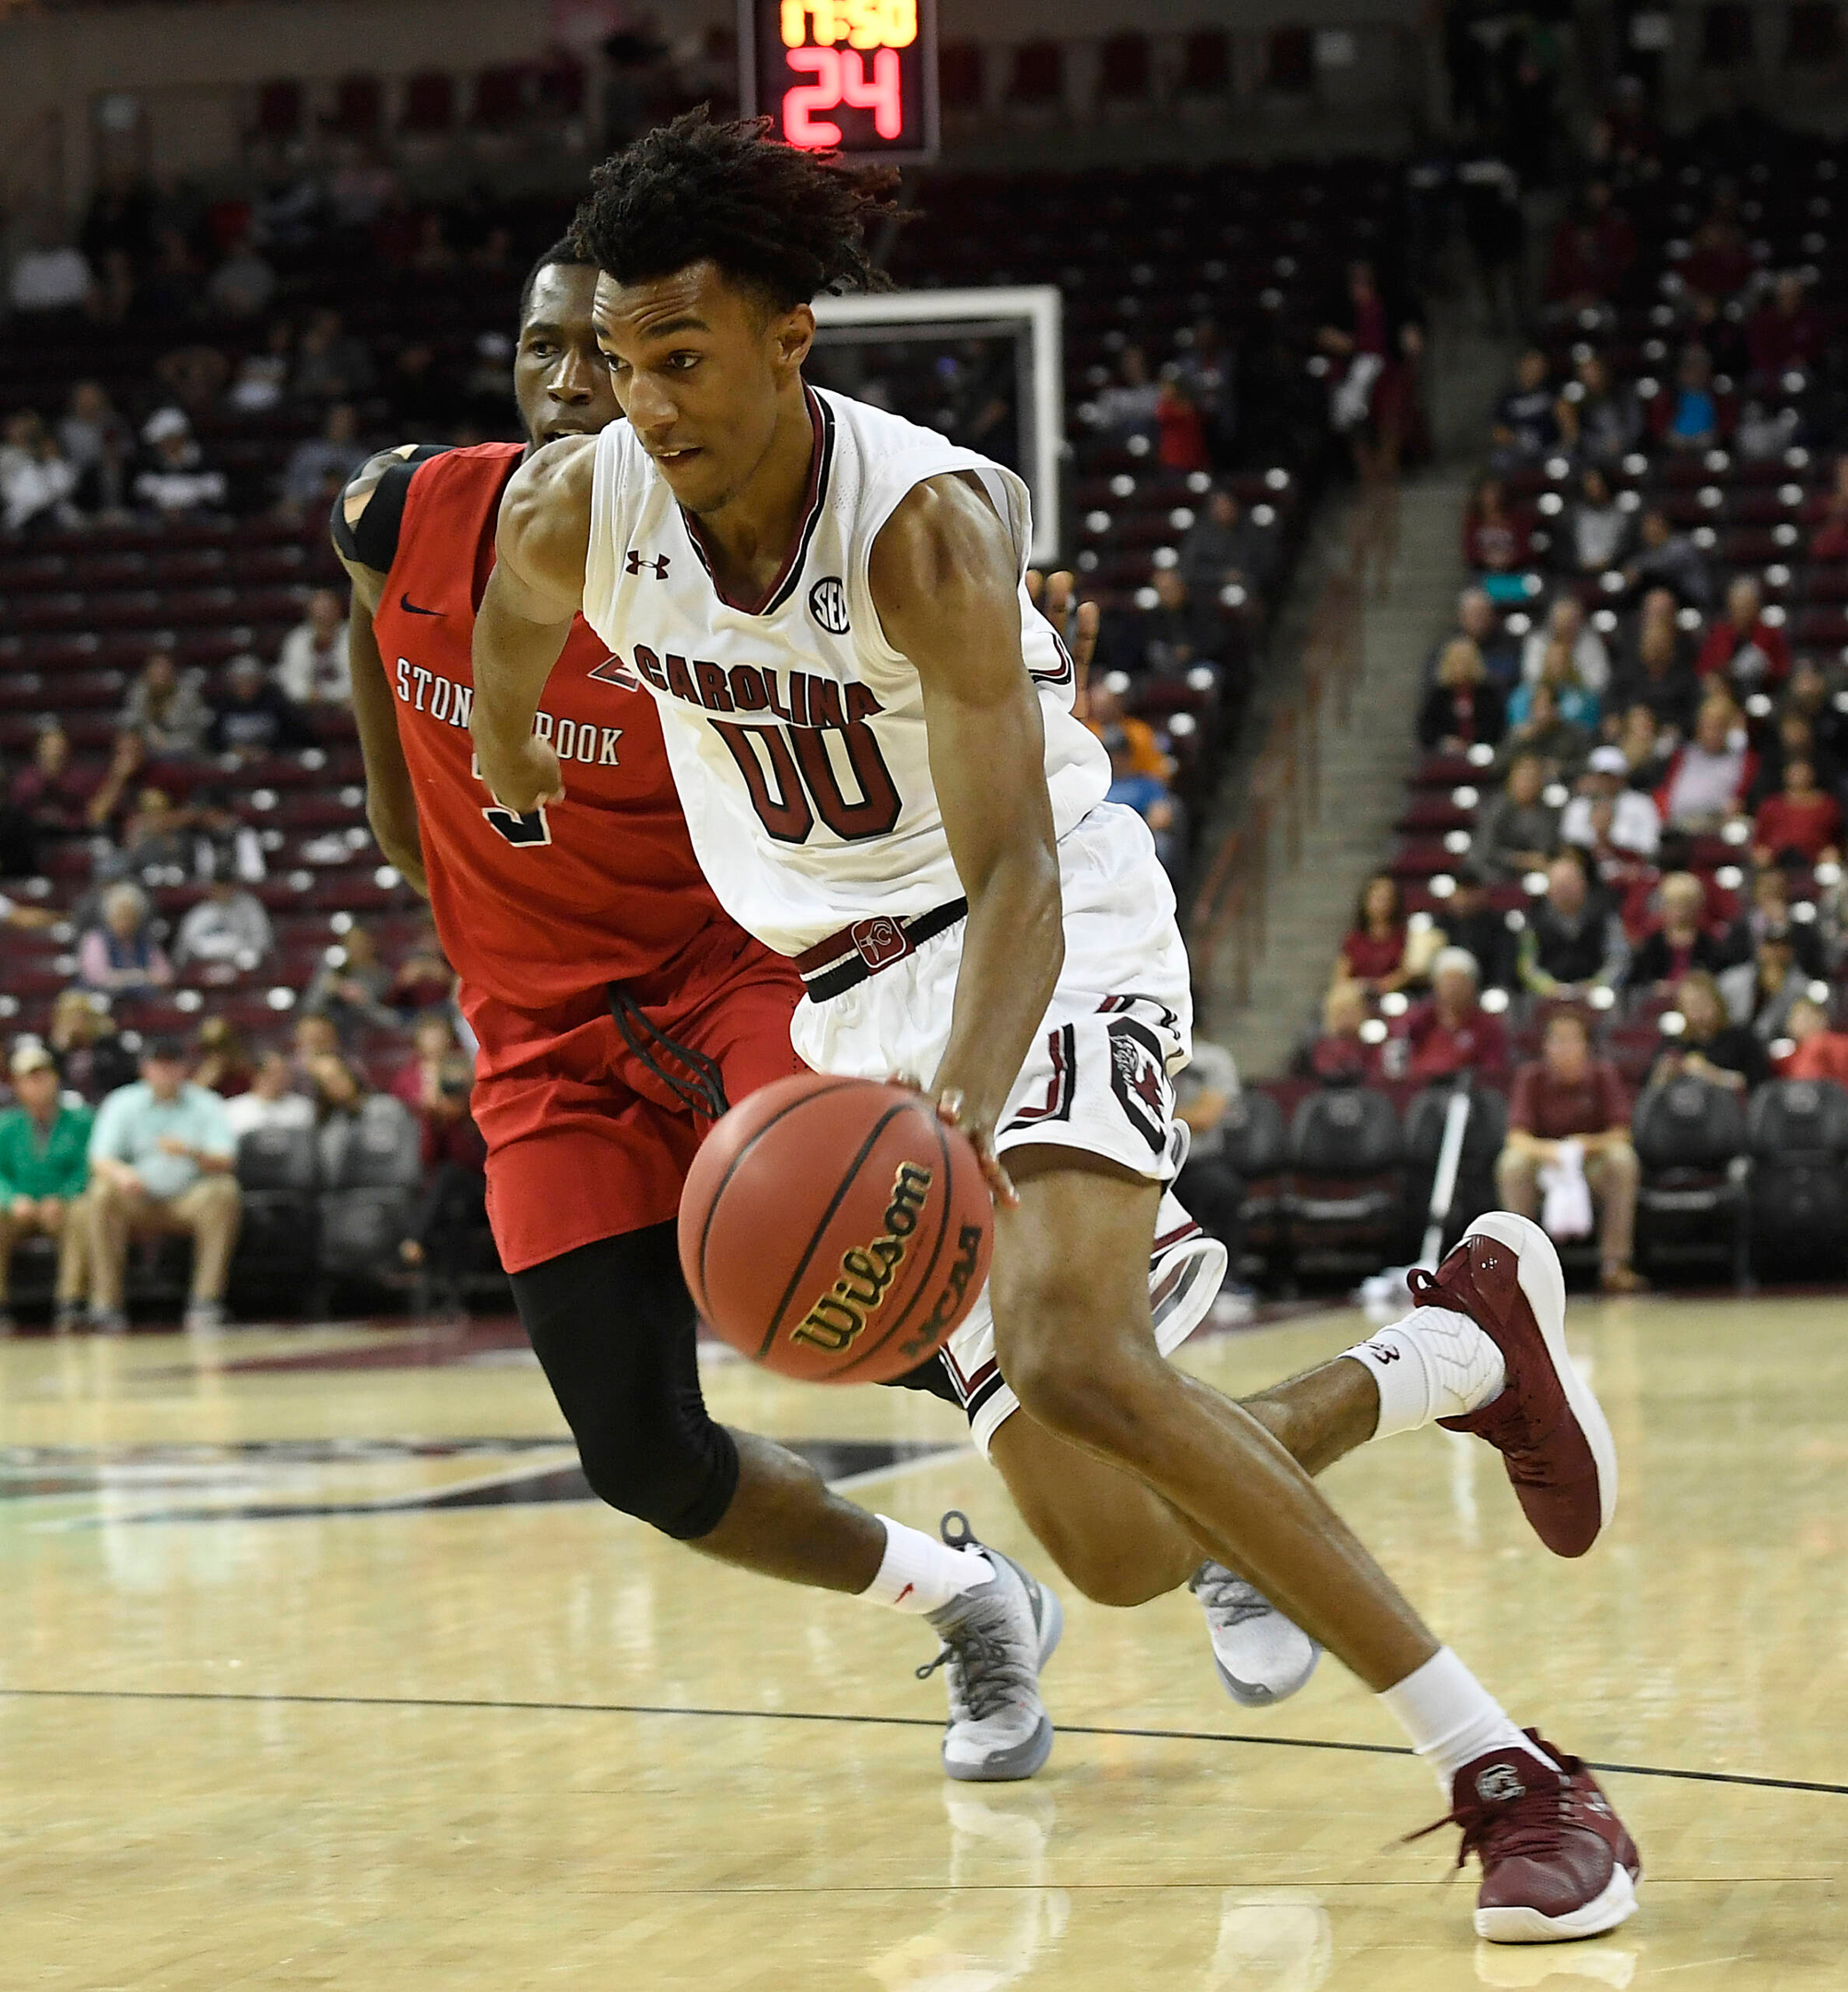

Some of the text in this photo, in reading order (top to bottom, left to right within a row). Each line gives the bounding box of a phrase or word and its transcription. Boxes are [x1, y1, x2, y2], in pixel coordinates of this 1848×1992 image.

[783, 47, 902, 147] 24
[396, 656, 623, 766] STON ROOK
[633, 643, 887, 727] CAROLINA
[706, 717, 903, 845] 00
[789, 1160, 933, 1356] Wilson
